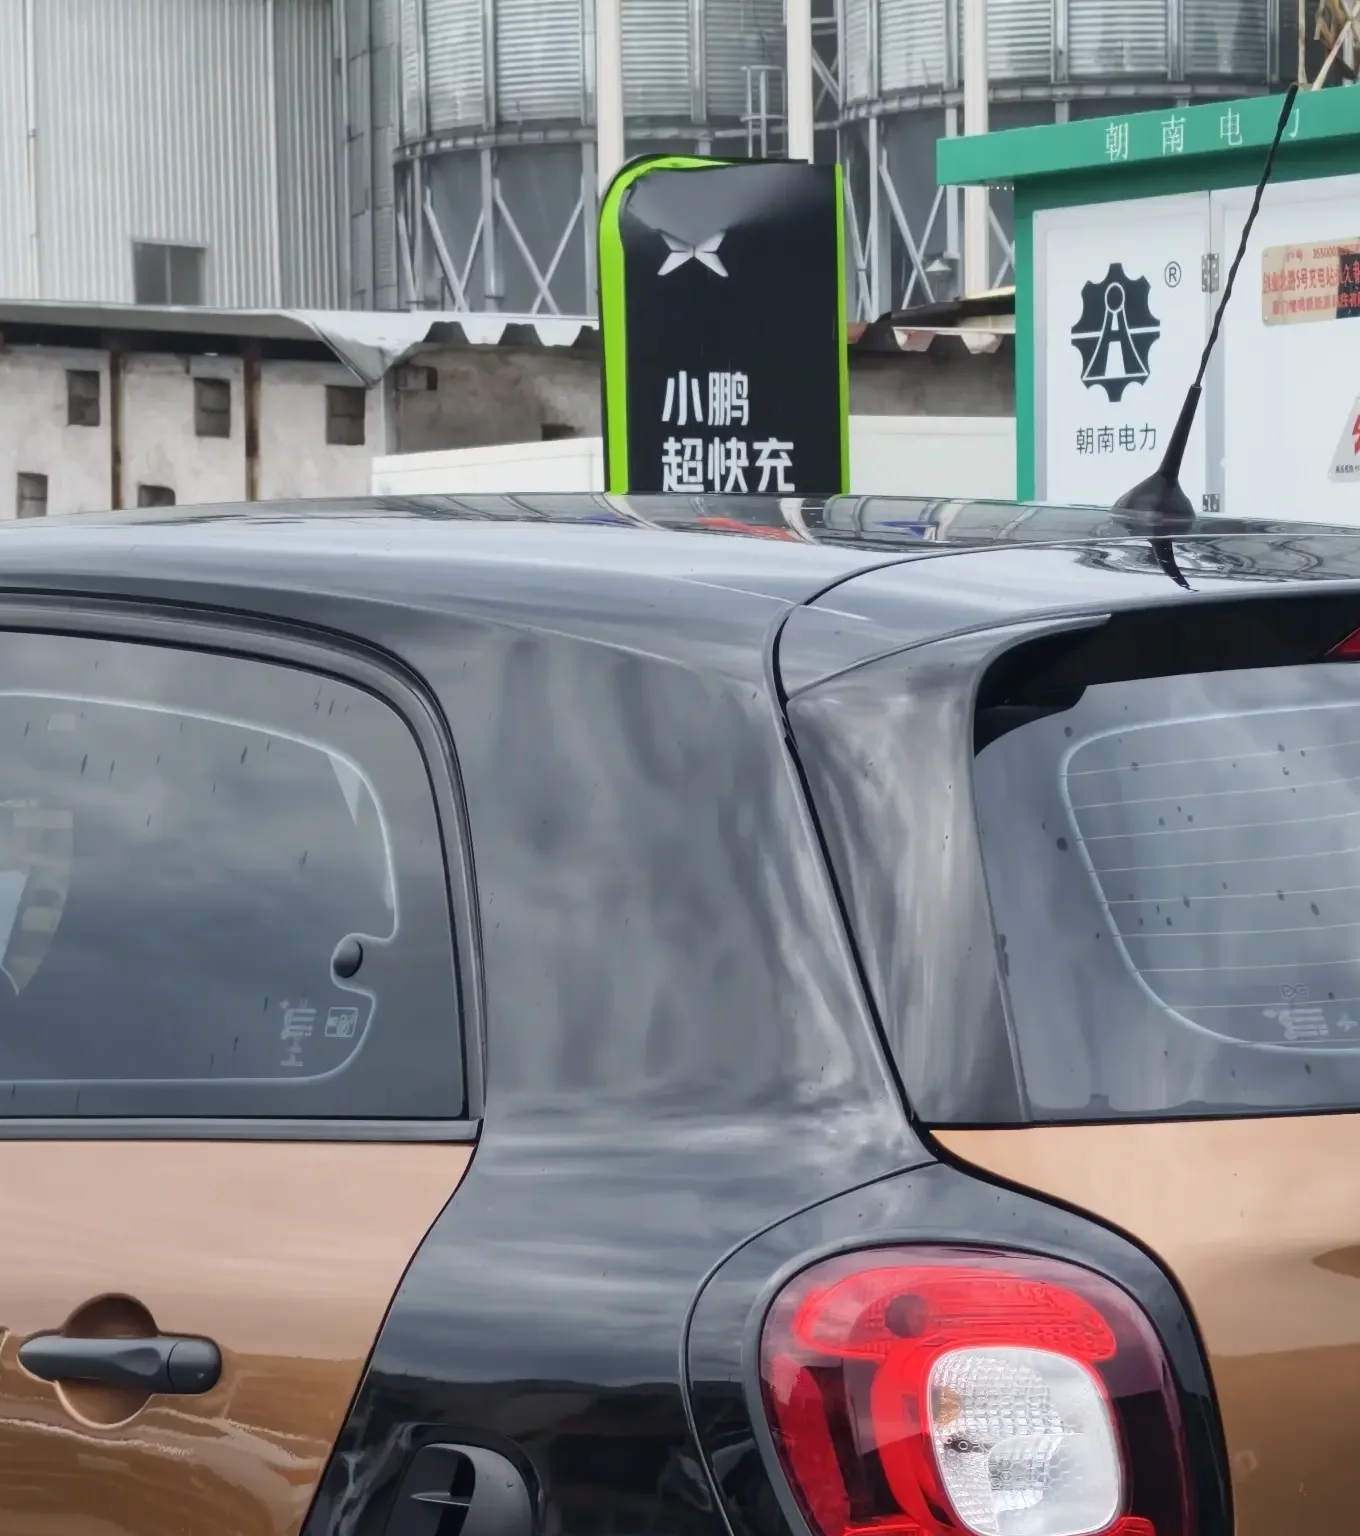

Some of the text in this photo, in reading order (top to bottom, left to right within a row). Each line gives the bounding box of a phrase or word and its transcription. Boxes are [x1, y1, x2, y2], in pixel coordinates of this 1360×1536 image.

[661, 370, 750, 426] 小鹏
[661, 436, 796, 493] 超快充
[1075, 422, 1157, 455] 朝南电力
